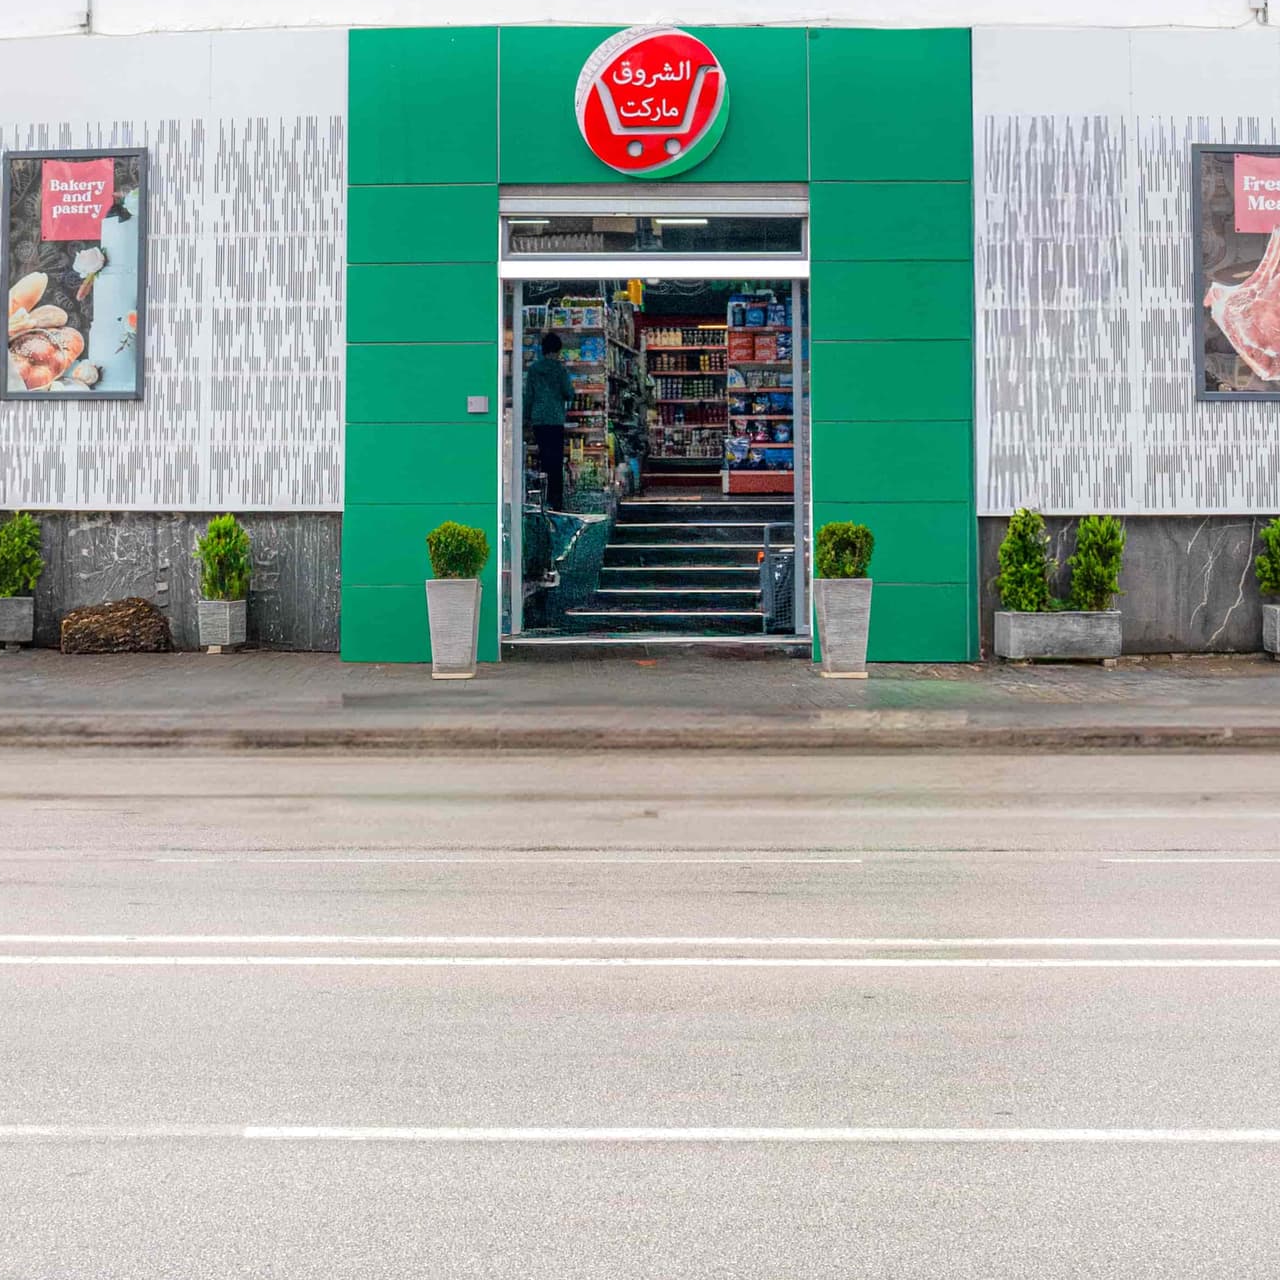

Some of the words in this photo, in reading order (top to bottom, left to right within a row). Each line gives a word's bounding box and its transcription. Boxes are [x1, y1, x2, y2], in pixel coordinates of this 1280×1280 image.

[612, 60, 691, 88] الشروق
[619, 97, 680, 122] ماركت
[49, 179, 105, 195] Bakery
[62, 190, 92, 202] and
[51, 203, 103, 219] pastry
